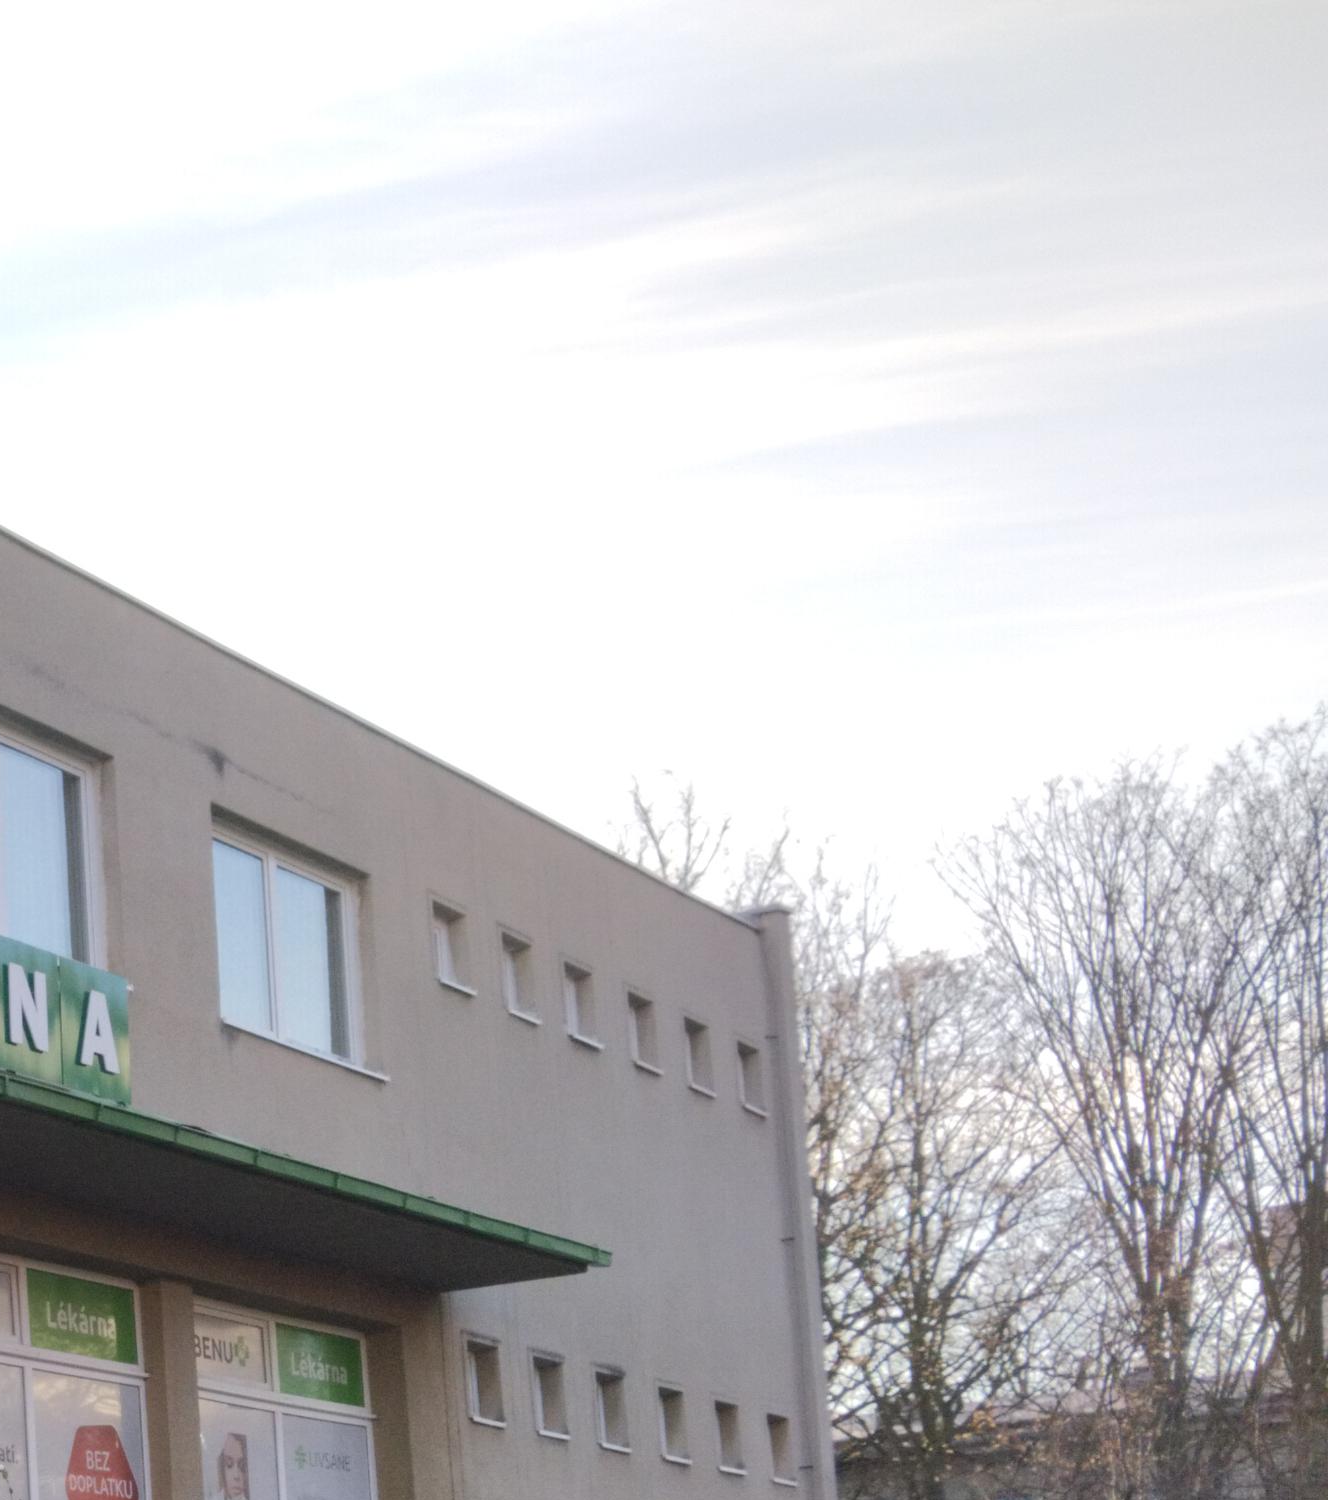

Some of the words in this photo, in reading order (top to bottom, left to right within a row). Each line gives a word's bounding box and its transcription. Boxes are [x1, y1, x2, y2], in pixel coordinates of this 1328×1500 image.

[46, 1301, 116, 1339] Lékárna
[291, 1351, 348, 1384] Lékárna
[85, 1450, 110, 1472] BEZ
[69, 1473, 133, 1499] DOPLATKU
